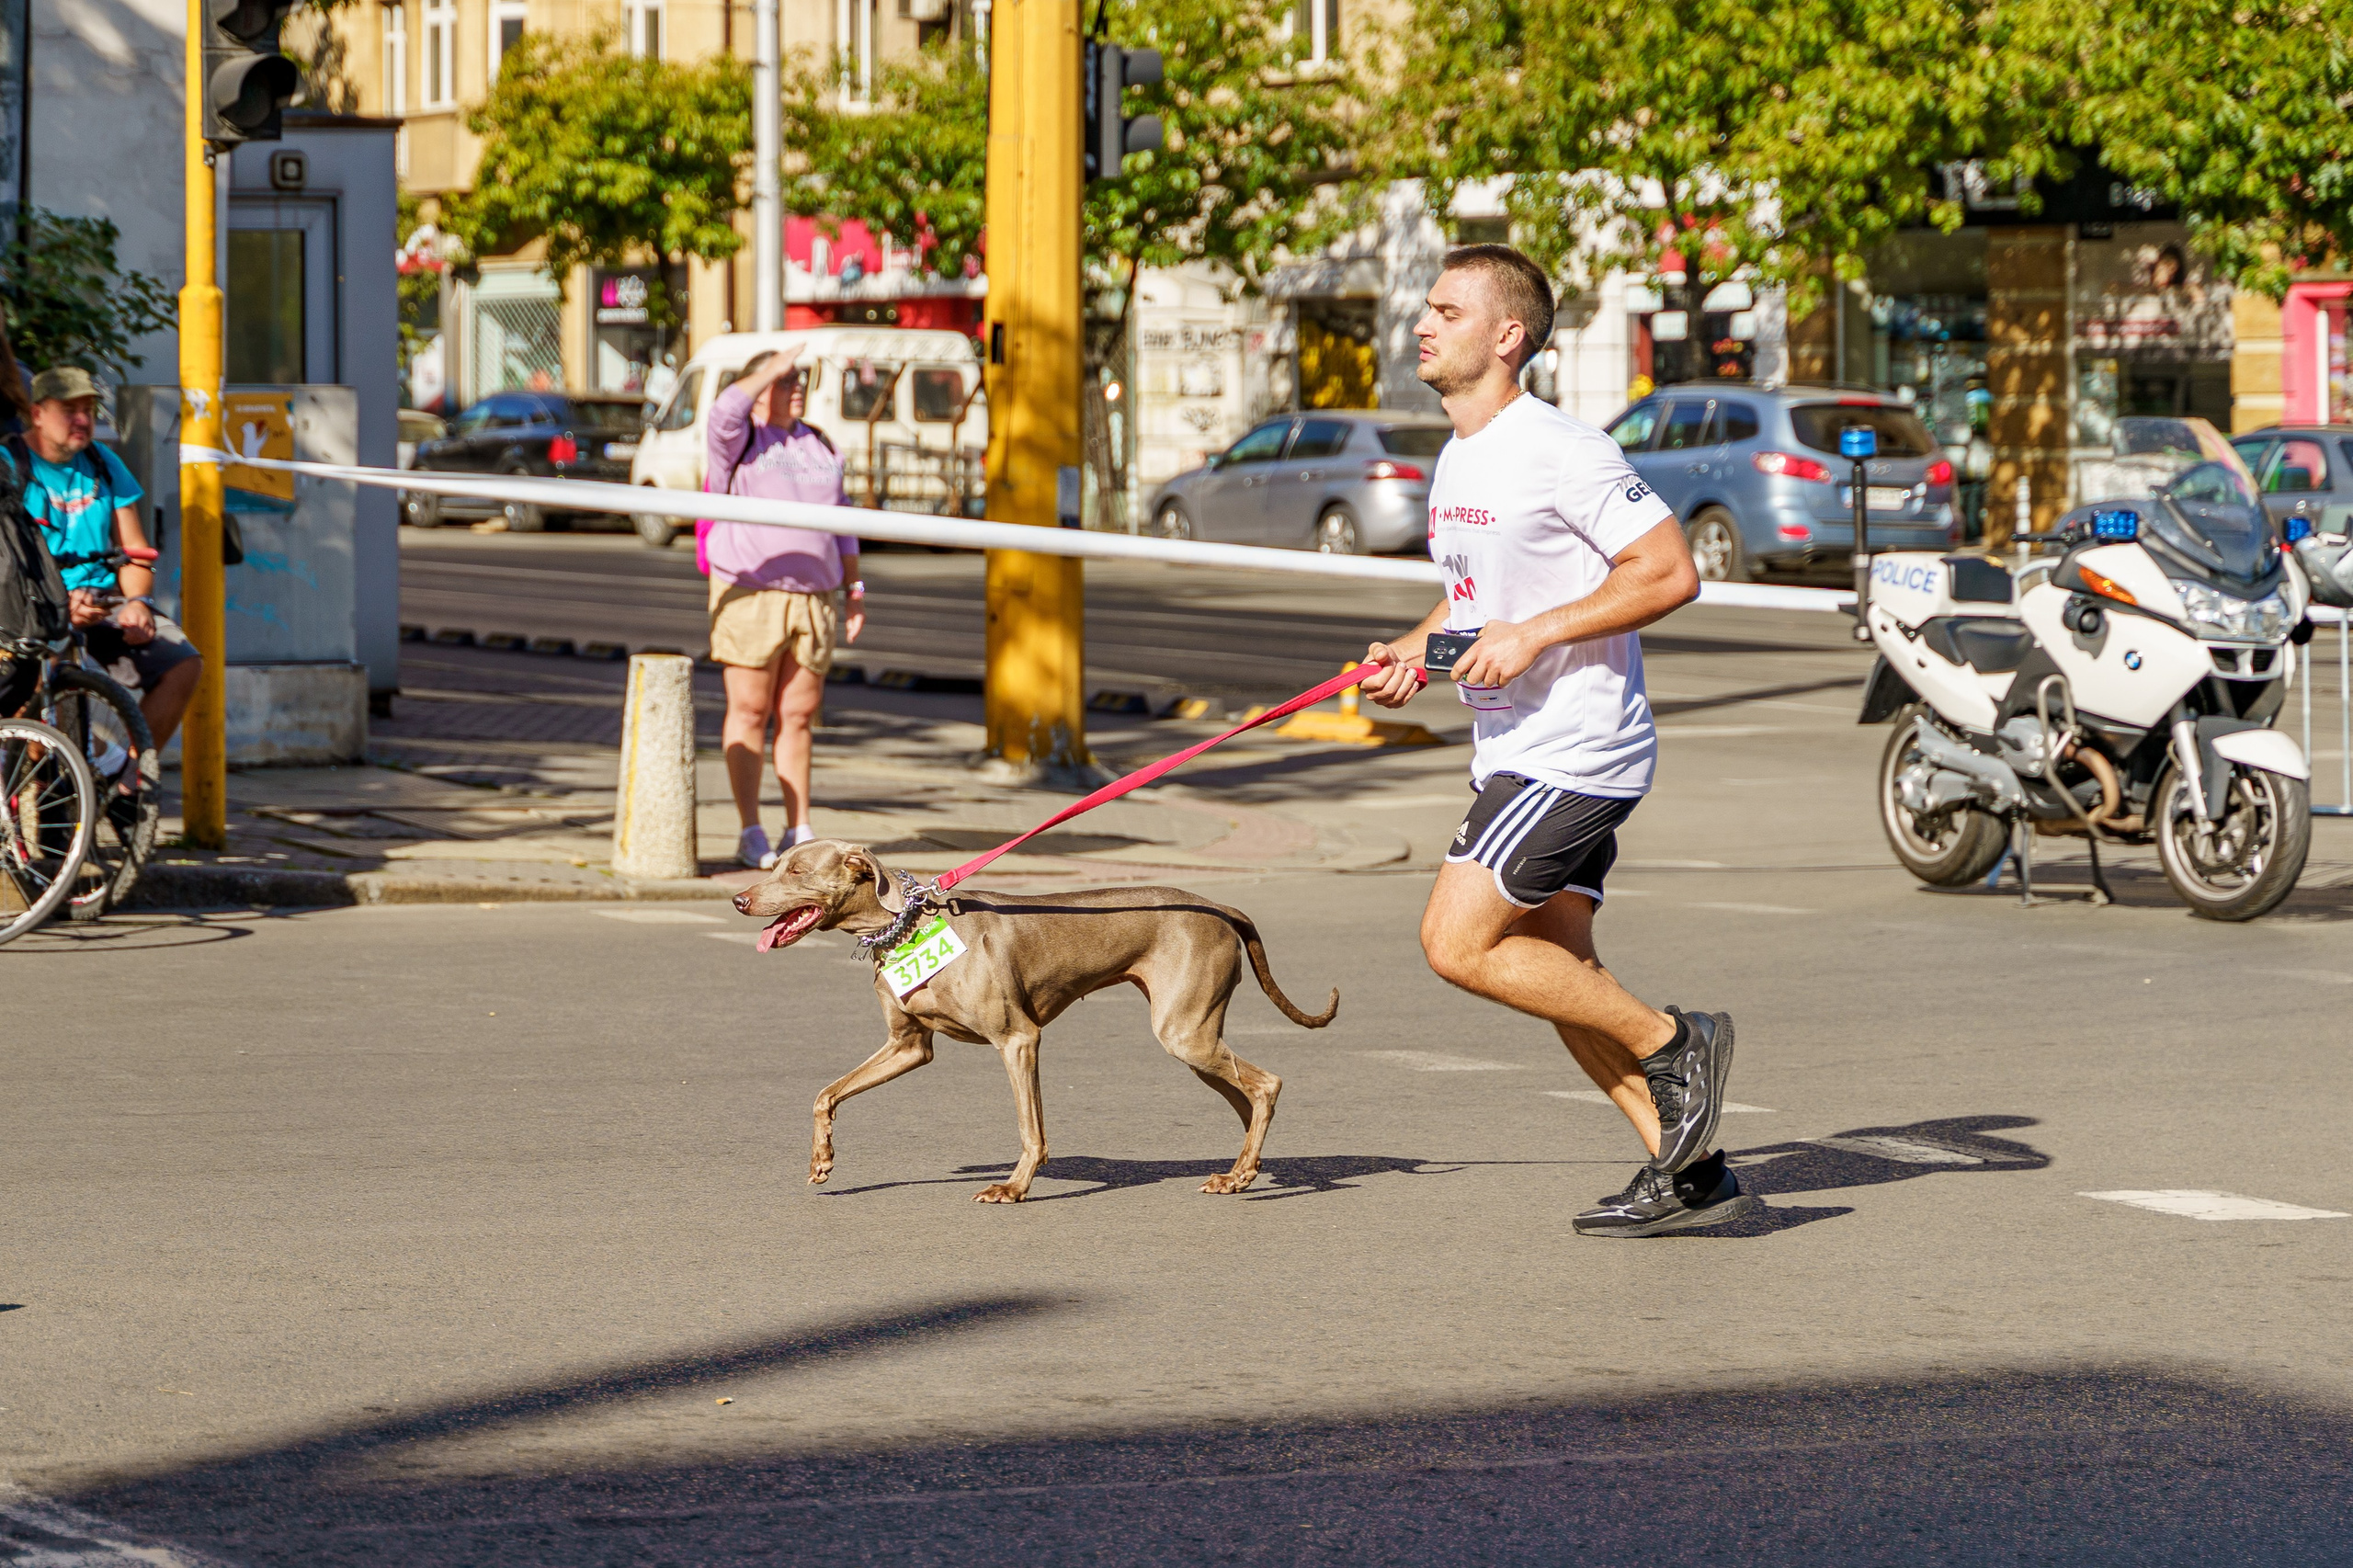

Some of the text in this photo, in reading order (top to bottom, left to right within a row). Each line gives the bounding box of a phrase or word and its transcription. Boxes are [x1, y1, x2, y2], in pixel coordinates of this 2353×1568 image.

[1626, 481, 1652, 503] GE
[1443, 506, 1489, 526] M-PRESS
[1871, 560, 1937, 593] POLICE
[893, 937, 954, 987] 3734
